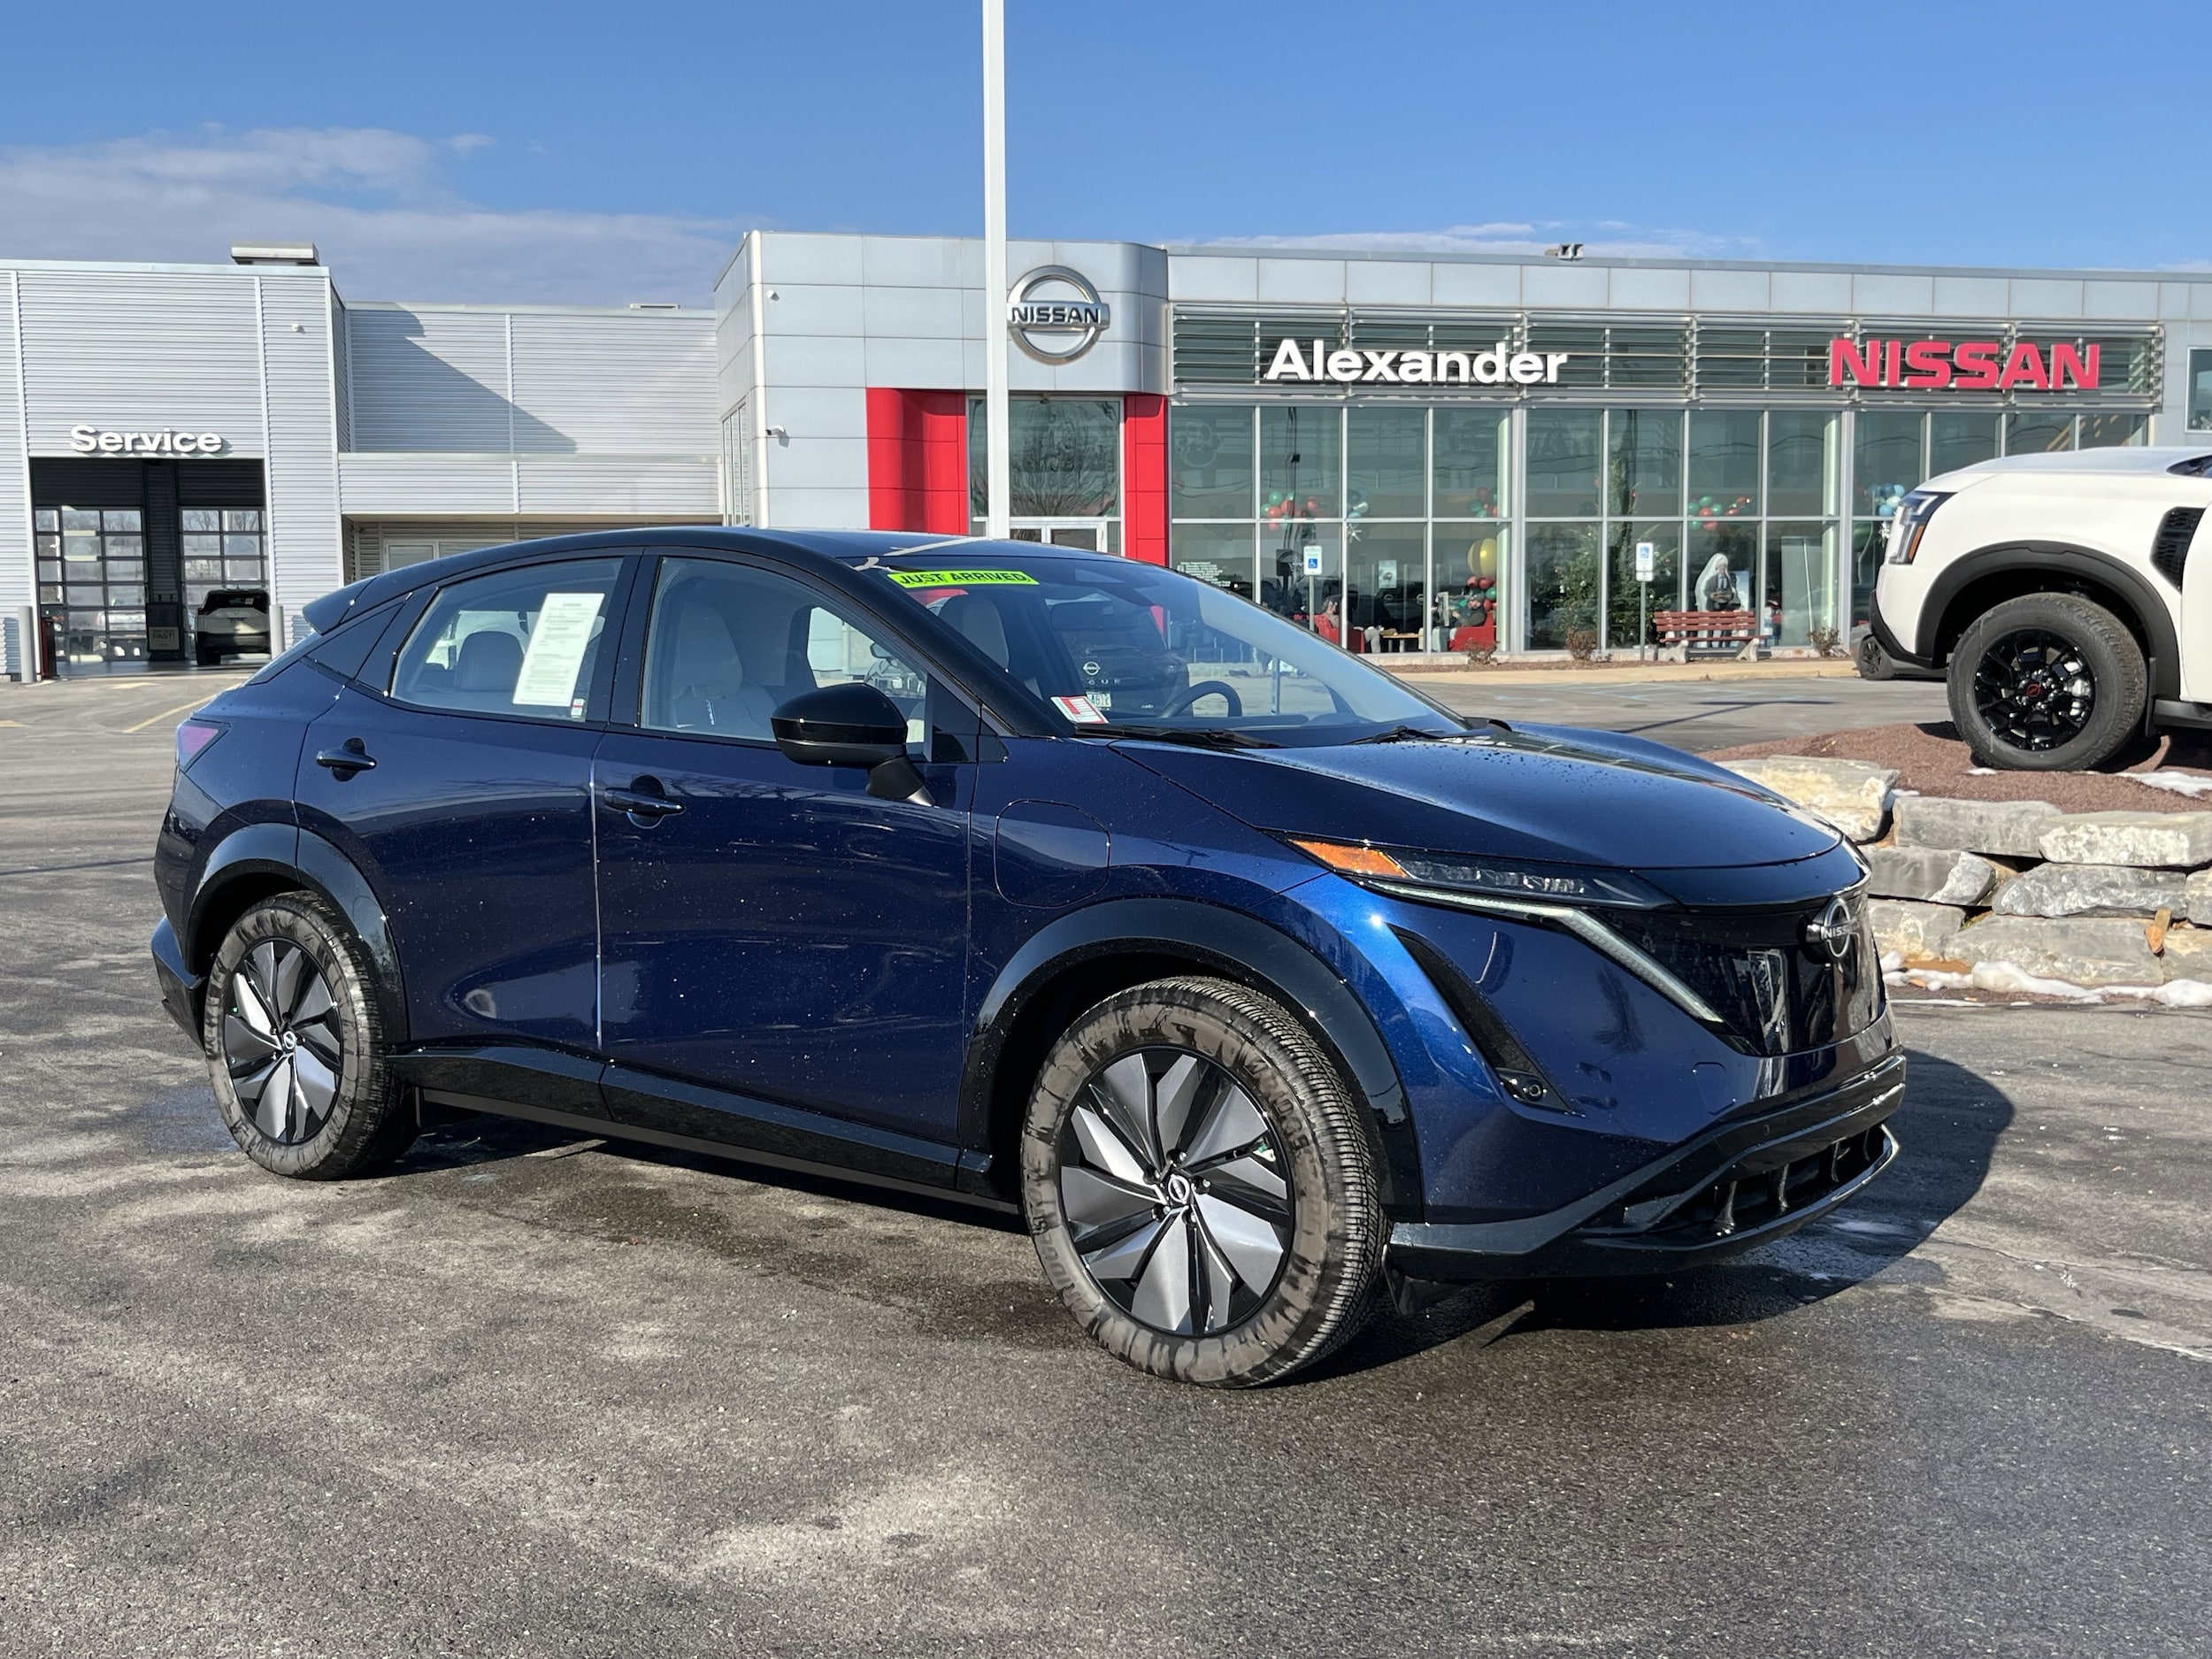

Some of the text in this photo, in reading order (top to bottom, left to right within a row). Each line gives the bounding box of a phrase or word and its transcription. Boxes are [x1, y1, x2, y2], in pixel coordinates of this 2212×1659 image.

[1011, 306, 1100, 323] NISSAN
[1265, 339, 1568, 384] Alexander
[1830, 340, 2101, 389] NISSAN
[70, 425, 223, 452] Service
[899, 572, 1029, 584] JUST ARRIVED
[1824, 925, 1851, 939] NISS
